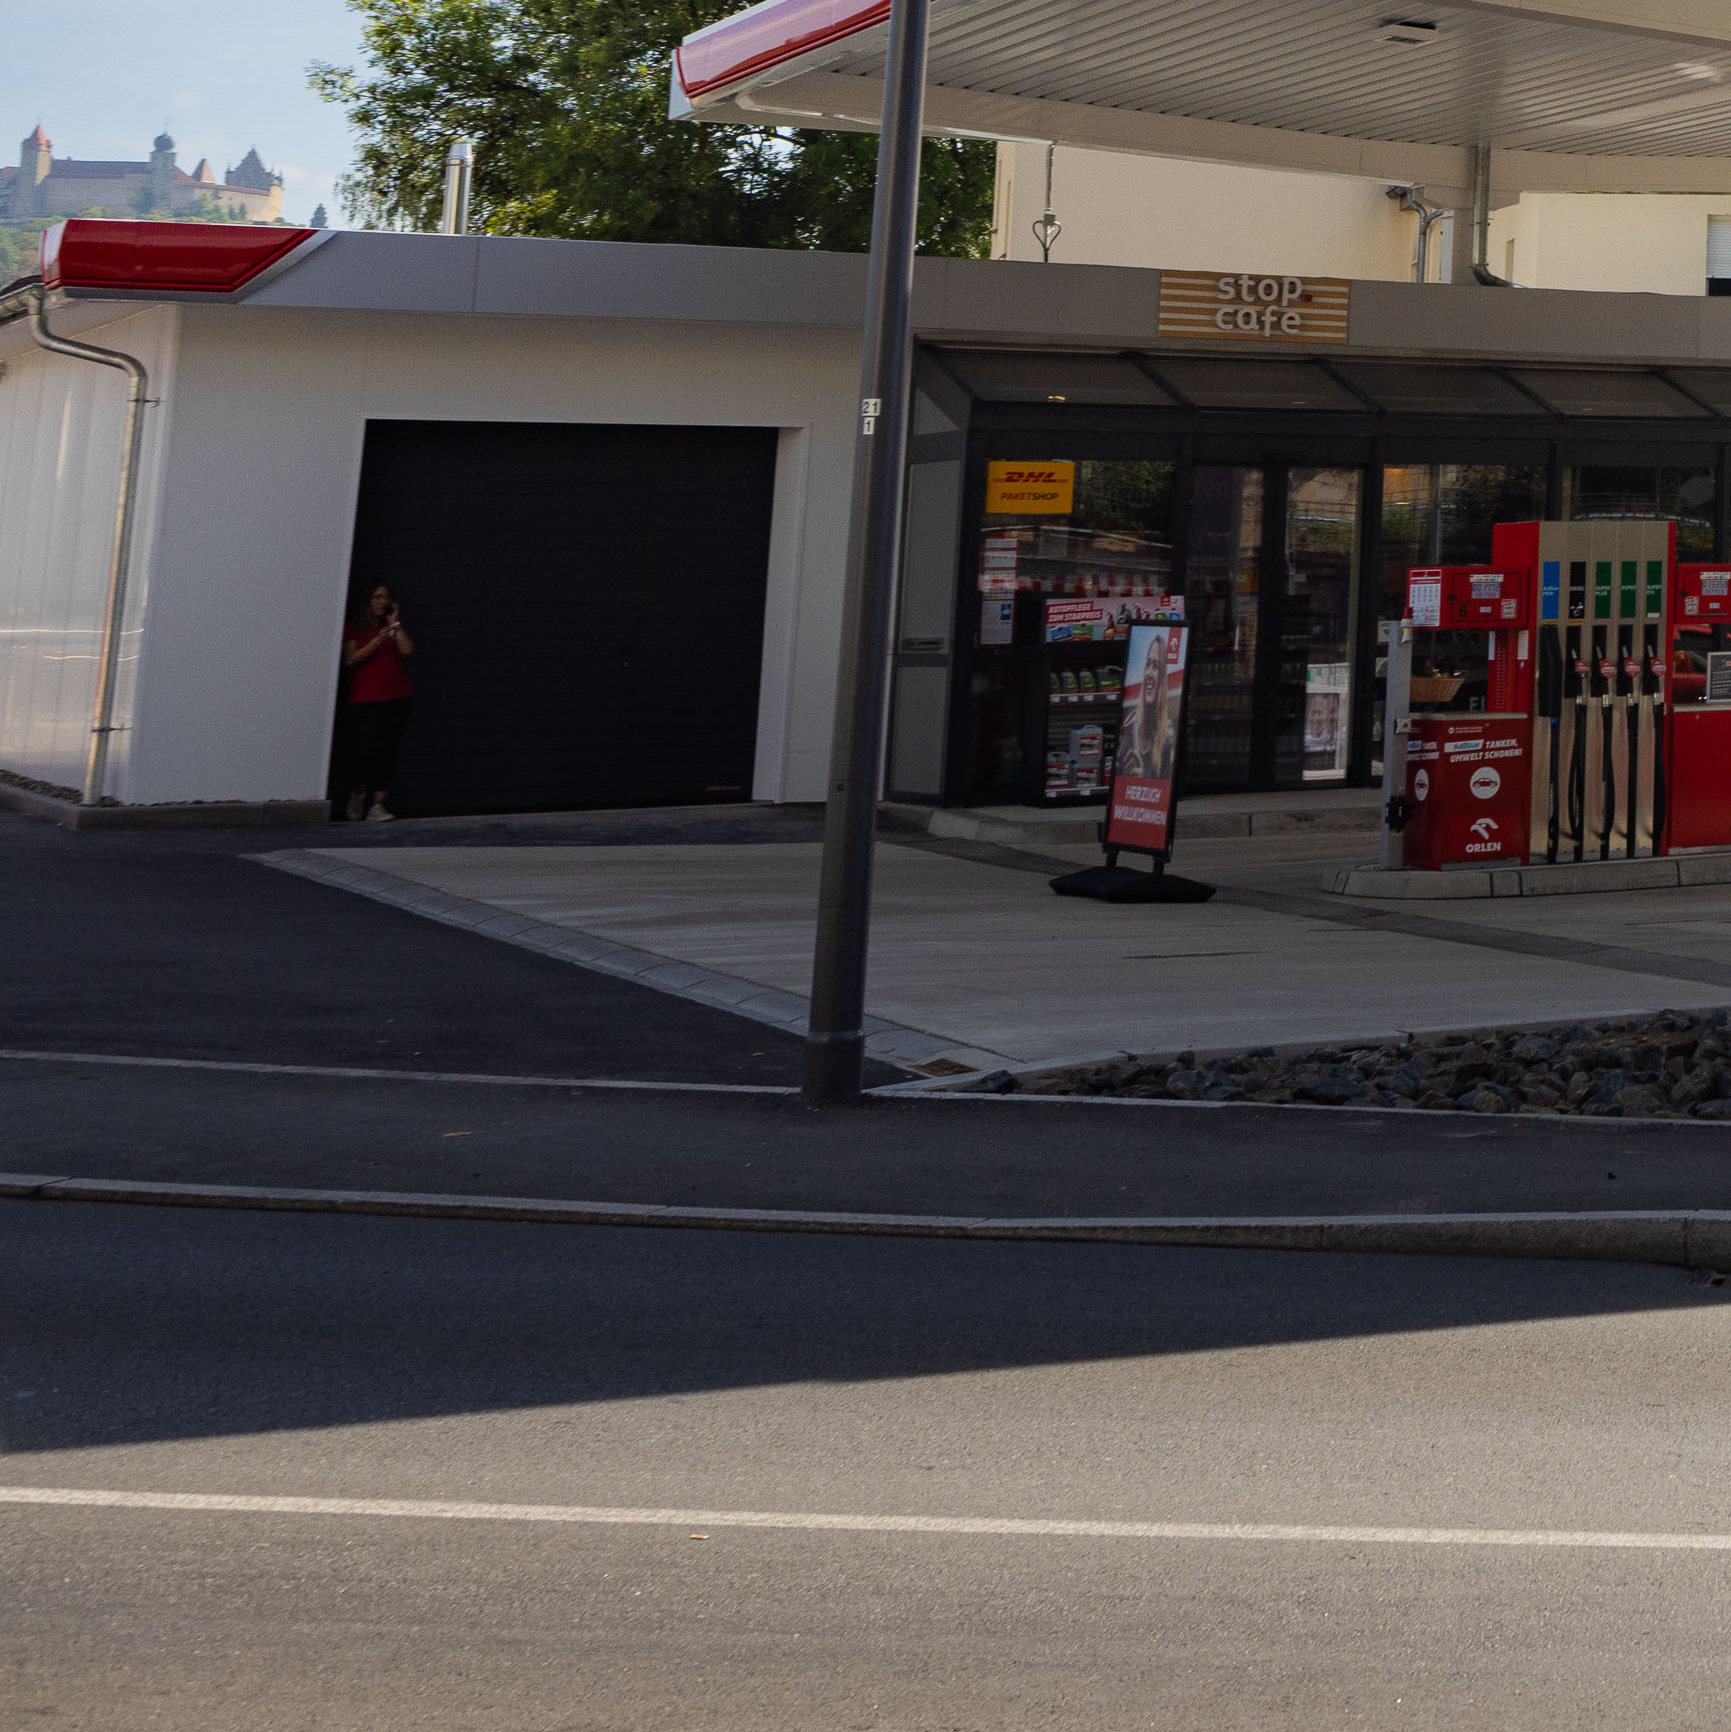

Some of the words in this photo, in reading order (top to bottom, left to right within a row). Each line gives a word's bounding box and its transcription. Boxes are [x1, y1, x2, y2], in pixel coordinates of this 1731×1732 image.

[1214, 305, 1301, 337] cafe
[863, 401, 878, 414] 21
[865, 420, 871, 432] 1
[1004, 471, 1057, 483] DHL
[1000, 492, 1060, 501] PAKETSHOP
[1486, 739, 1518, 749] TANKEN,
[1450, 752, 1483, 763] UMWELT
[1484, 748, 1523, 760] SCHONEN!
[1465, 842, 1501, 853] ORLEN
